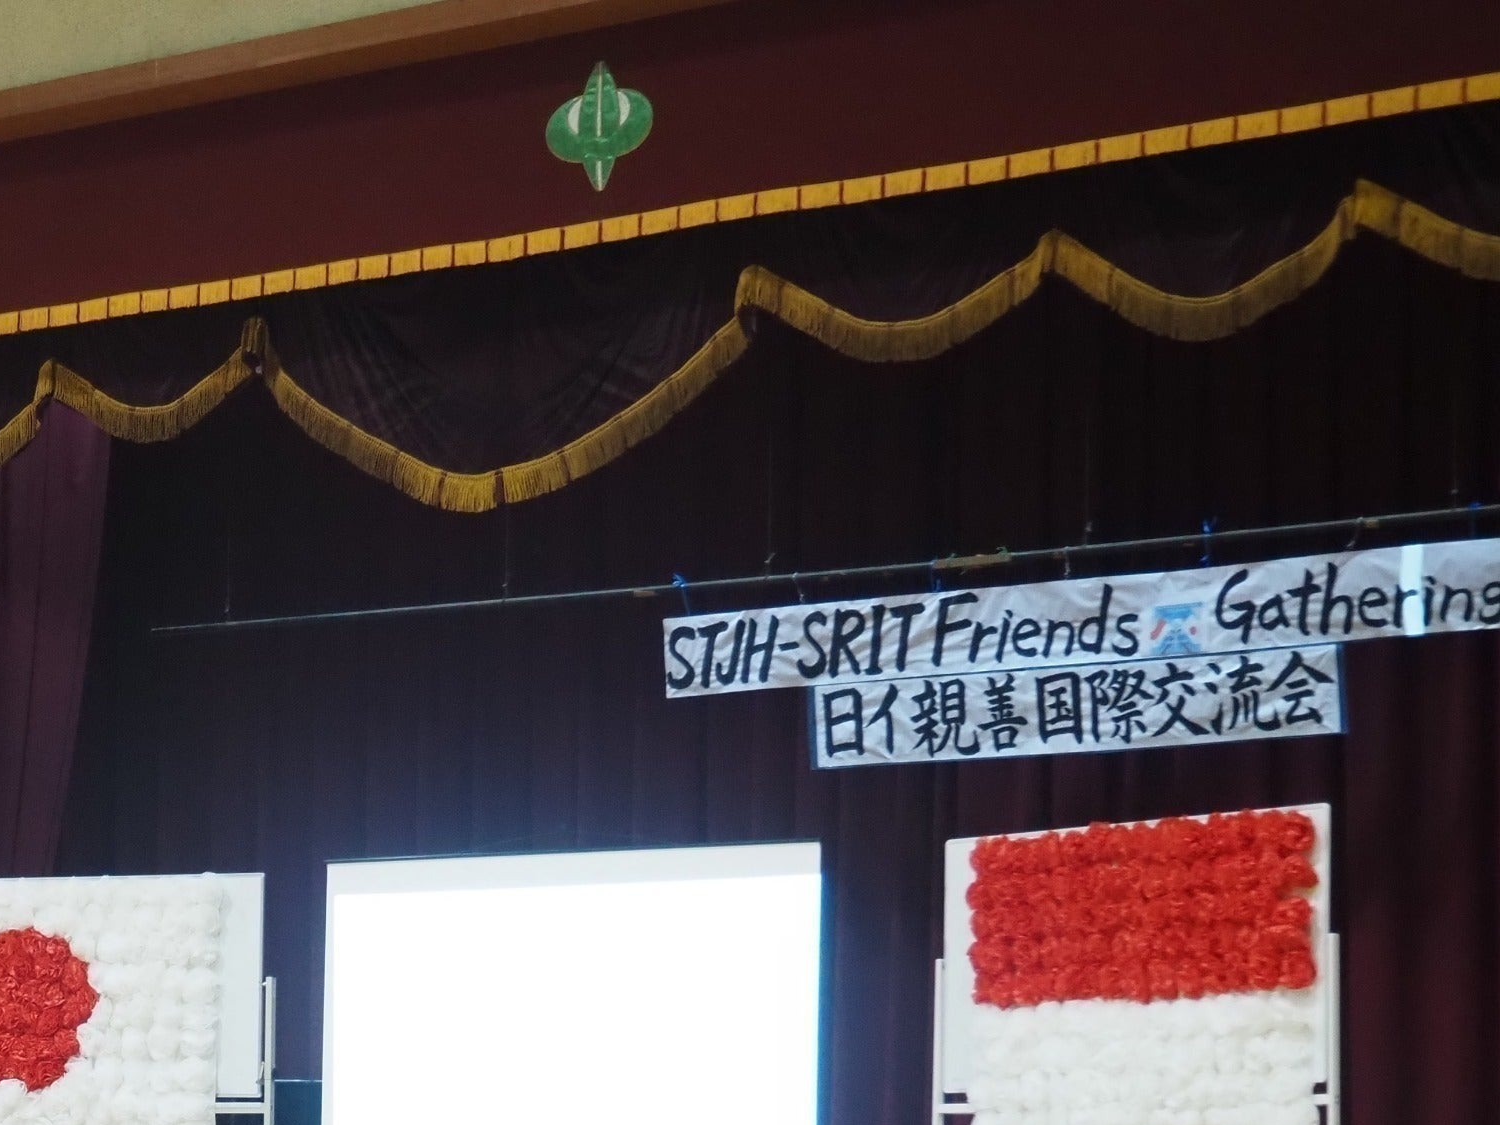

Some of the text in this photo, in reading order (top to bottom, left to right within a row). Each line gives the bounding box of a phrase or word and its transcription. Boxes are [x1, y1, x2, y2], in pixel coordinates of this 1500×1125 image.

[931, 584, 1139, 668] Friends
[1214, 562, 1500, 644] Gathering
[822, 650, 1335, 758] 日イ親善国際交流会
